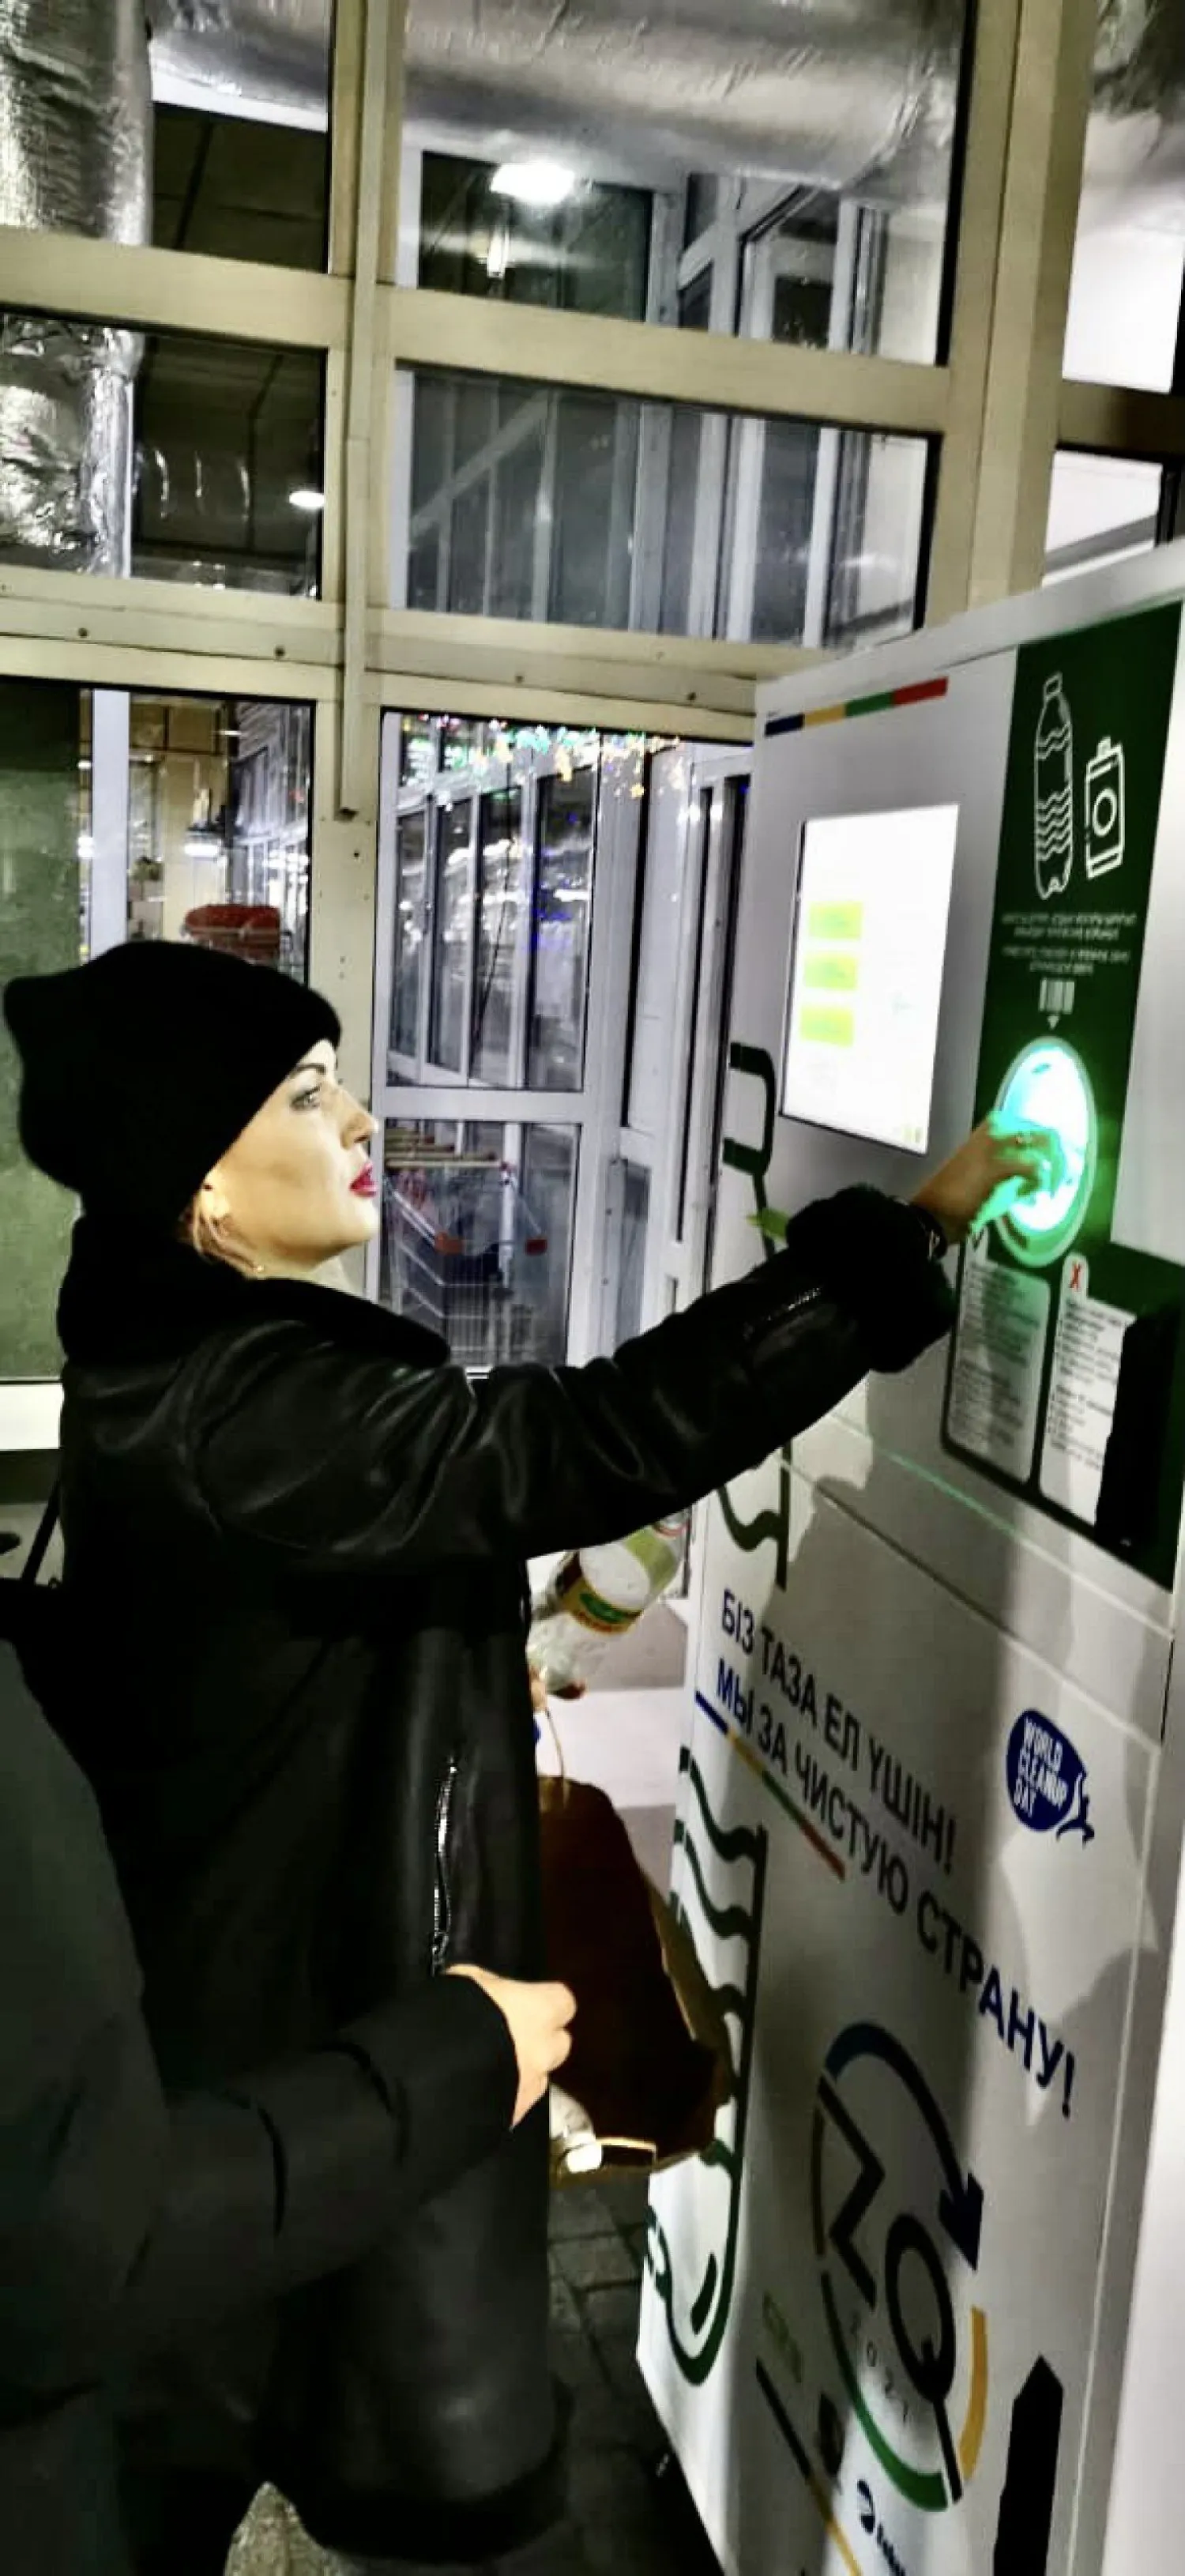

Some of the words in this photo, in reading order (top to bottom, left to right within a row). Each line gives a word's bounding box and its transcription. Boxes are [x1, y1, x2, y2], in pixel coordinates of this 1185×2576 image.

[721, 1588, 754, 1655] БІЗ
[761, 1625, 817, 1729] ТАЗА
[824, 1692, 859, 1772] ЕЛ
[1024, 1716, 1063, 1776] WORLD
[717, 1657, 754, 1736] МЫ
[758, 1703, 788, 1777] ЗА
[795, 1740, 908, 1915] ЧИСТУЮ
[916, 1889, 1074, 2119] СТРАНУ!
